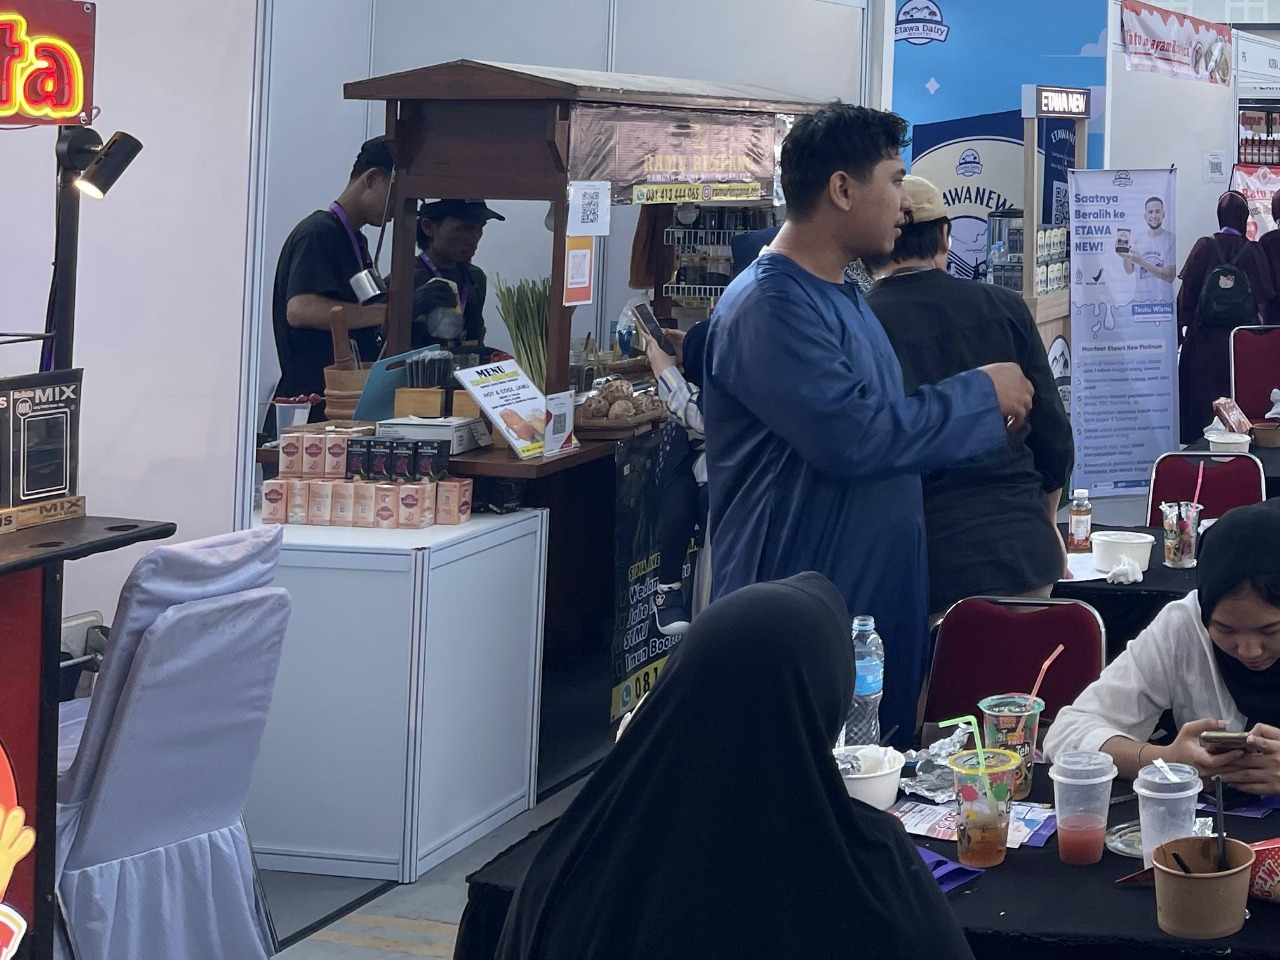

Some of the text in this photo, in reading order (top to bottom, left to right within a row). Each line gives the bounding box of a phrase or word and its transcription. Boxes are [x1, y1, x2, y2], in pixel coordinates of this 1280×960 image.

[1041, 91, 1087, 113] ETAWA NEW
[1051, 129, 1076, 145] ETAWANE
[942, 186, 1014, 211] AWANEW
[1074, 193, 1119, 205] Saatnya
[1074, 209, 1126, 219] Beralih ke
[1074, 225, 1112, 236] ETAWA
[1075, 242, 1104, 252] NEW!
[1152, 305, 1172, 313] Wisnu
[475, 366, 506, 378] MENU
[34, 385, 77, 404] MIX
[39, 498, 82, 515] MIX
[628, 576, 659, 604] Wedan
[625, 648, 648, 672] Imun
[635, 666, 659, 700] 081
[1016, 744, 1030, 756] Teh
